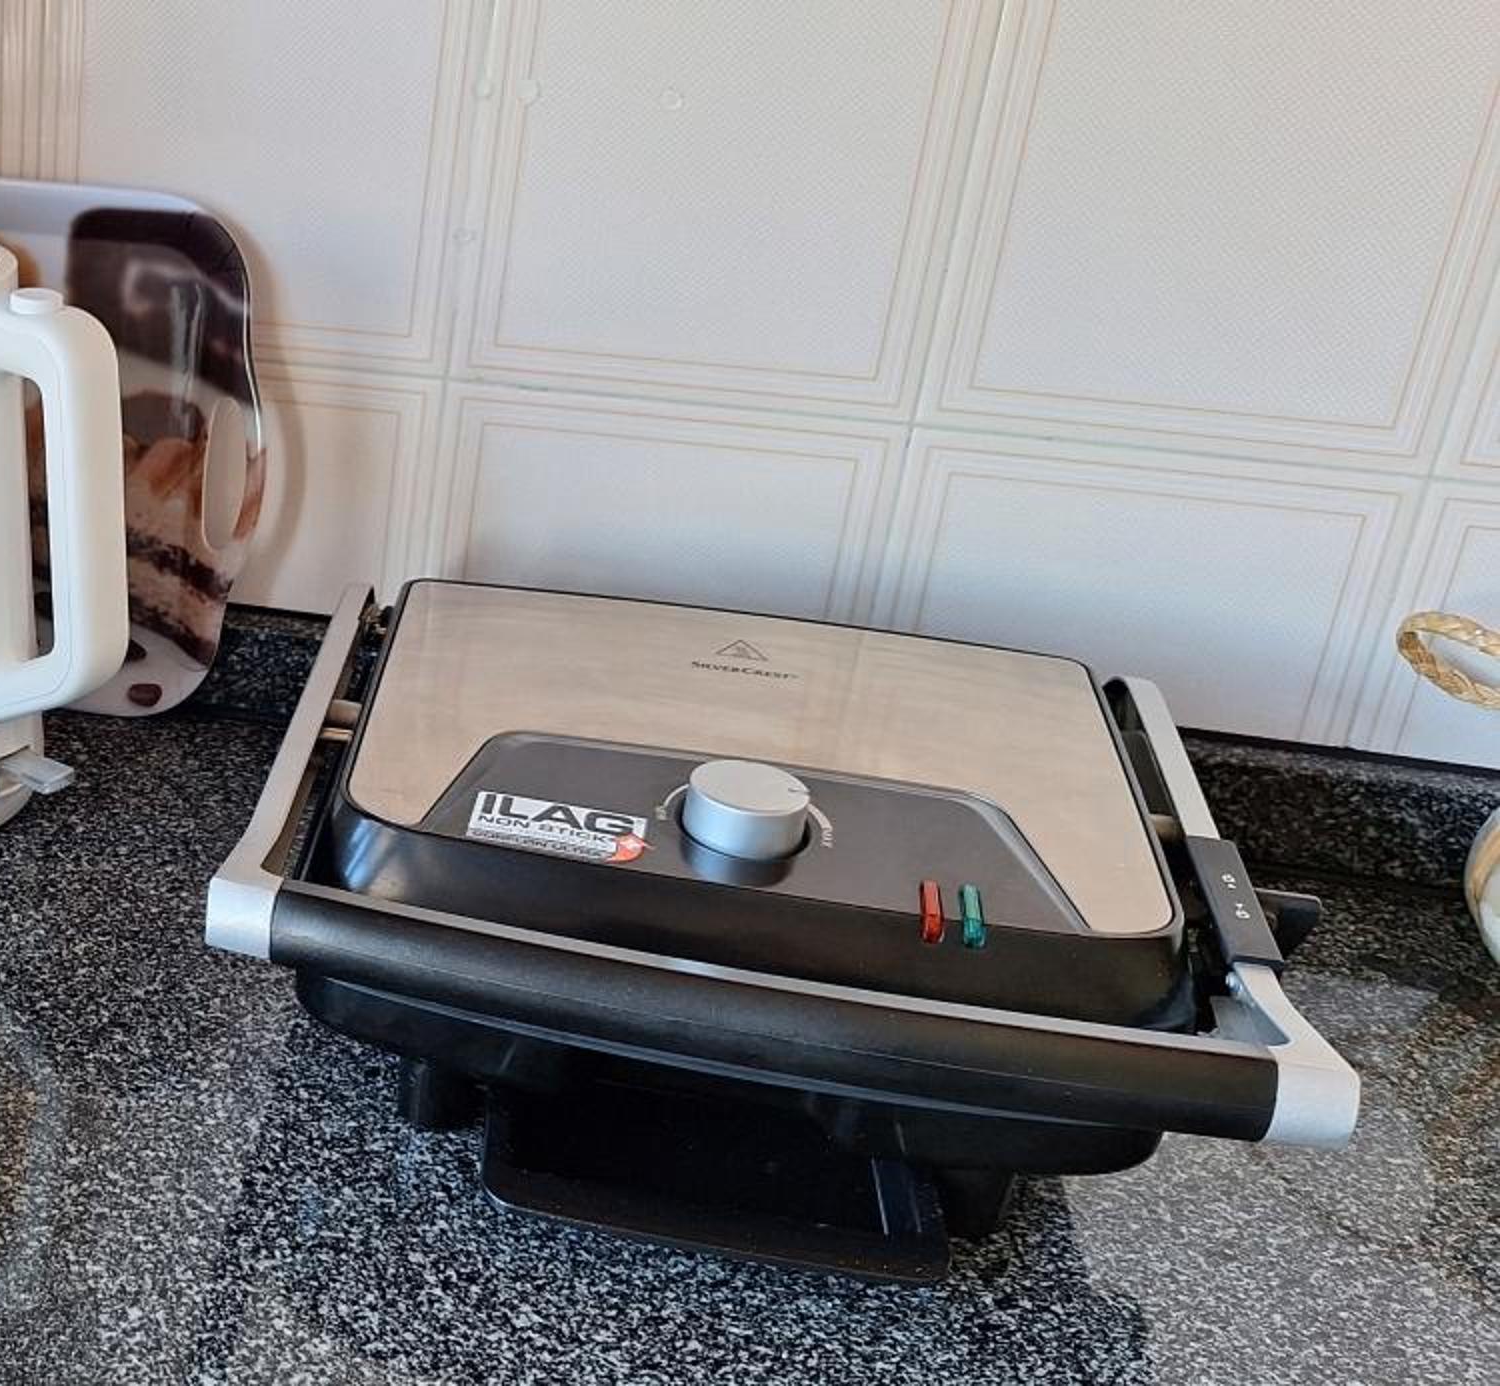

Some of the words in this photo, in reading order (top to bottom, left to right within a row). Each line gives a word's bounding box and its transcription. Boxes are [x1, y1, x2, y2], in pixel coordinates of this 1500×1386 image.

[477, 815, 530, 829] NON
[540, 822, 607, 843] STICK
[481, 793, 635, 836] ILAG
